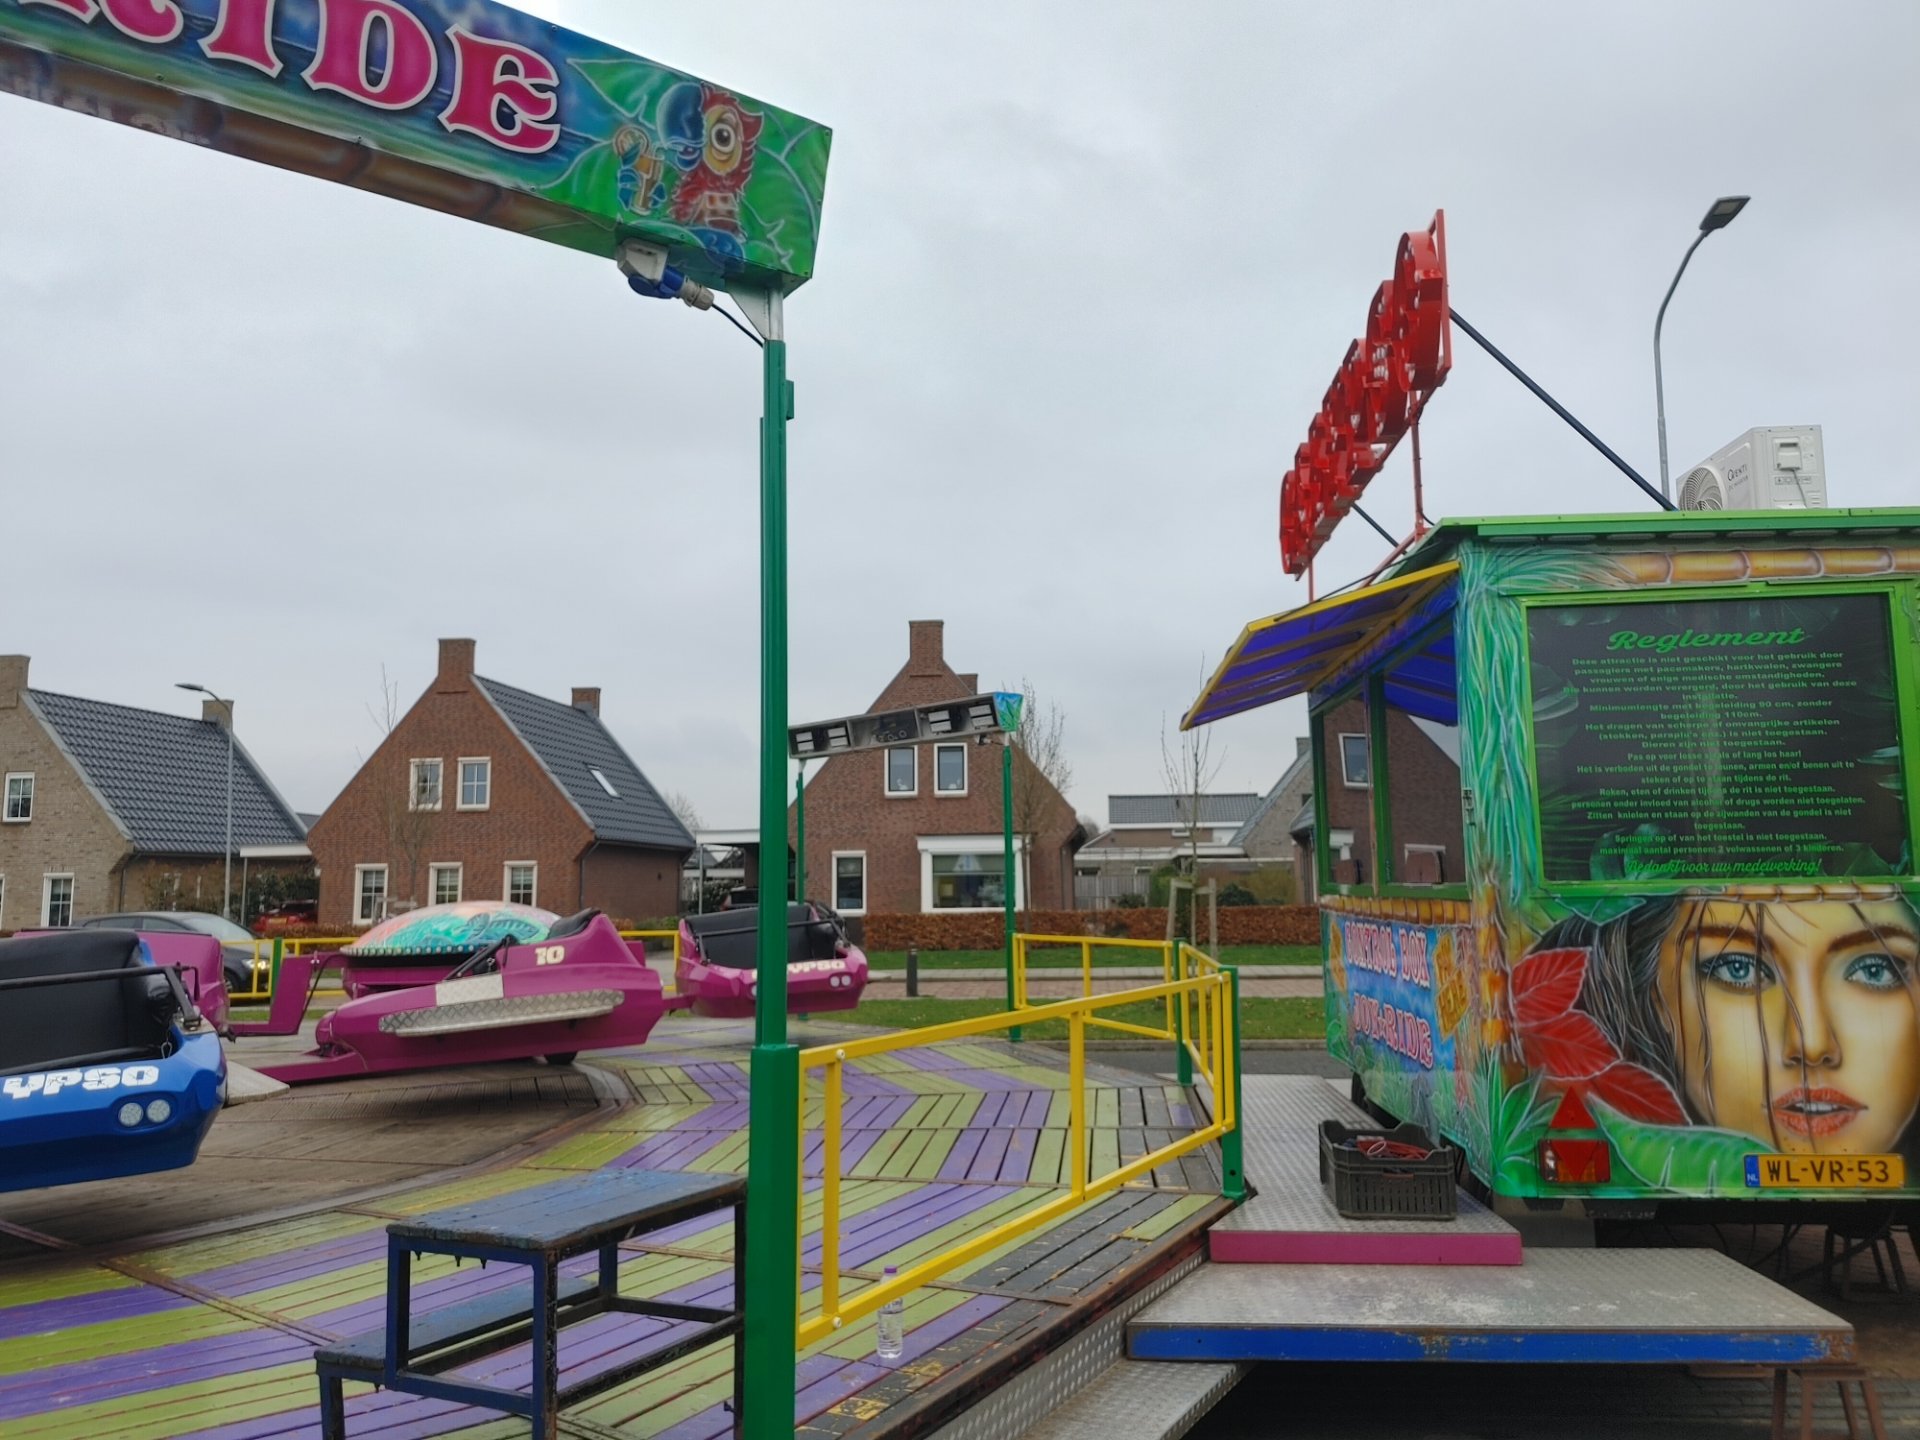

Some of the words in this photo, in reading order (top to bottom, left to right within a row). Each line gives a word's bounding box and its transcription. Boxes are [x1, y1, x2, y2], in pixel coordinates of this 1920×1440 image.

[1606, 628, 1812, 653] Reglement
[1684, 655, 1728, 663] geschikt
[1735, 672, 1824, 680] omstandigheden.
[1768, 681, 1807, 689] gebruik
[1696, 702, 1755, 710] begeleiding
[1726, 720, 1789, 728] omvangrijke
[1765, 729, 1827, 737] toegestaan.
[1743, 751, 1762, 759] lang
[1673, 764, 1700, 772] gondel
[1734, 774, 1763, 782] tijdens
[1698, 787, 1727, 795] tijdens
[1736, 798, 1760, 806] drugs
[1817, 796, 1865, 805] toegelaten.
[1794, 809, 1822, 817] gondel
[1776, 833, 1827, 841] toegestaan.
[1803, 844, 1844, 852] kinderen.
[1681, 862, 1710, 872] voor
[1732, 858, 1822, 873] medewerking!
[534, 945, 565, 965] 10
[1399, 928, 1431, 988] BOX
[3, 1065, 160, 1099] YPSO
[1747, 1173, 1759, 1182] NL
[1767, 1160, 1890, 1183] WL-VR-53
